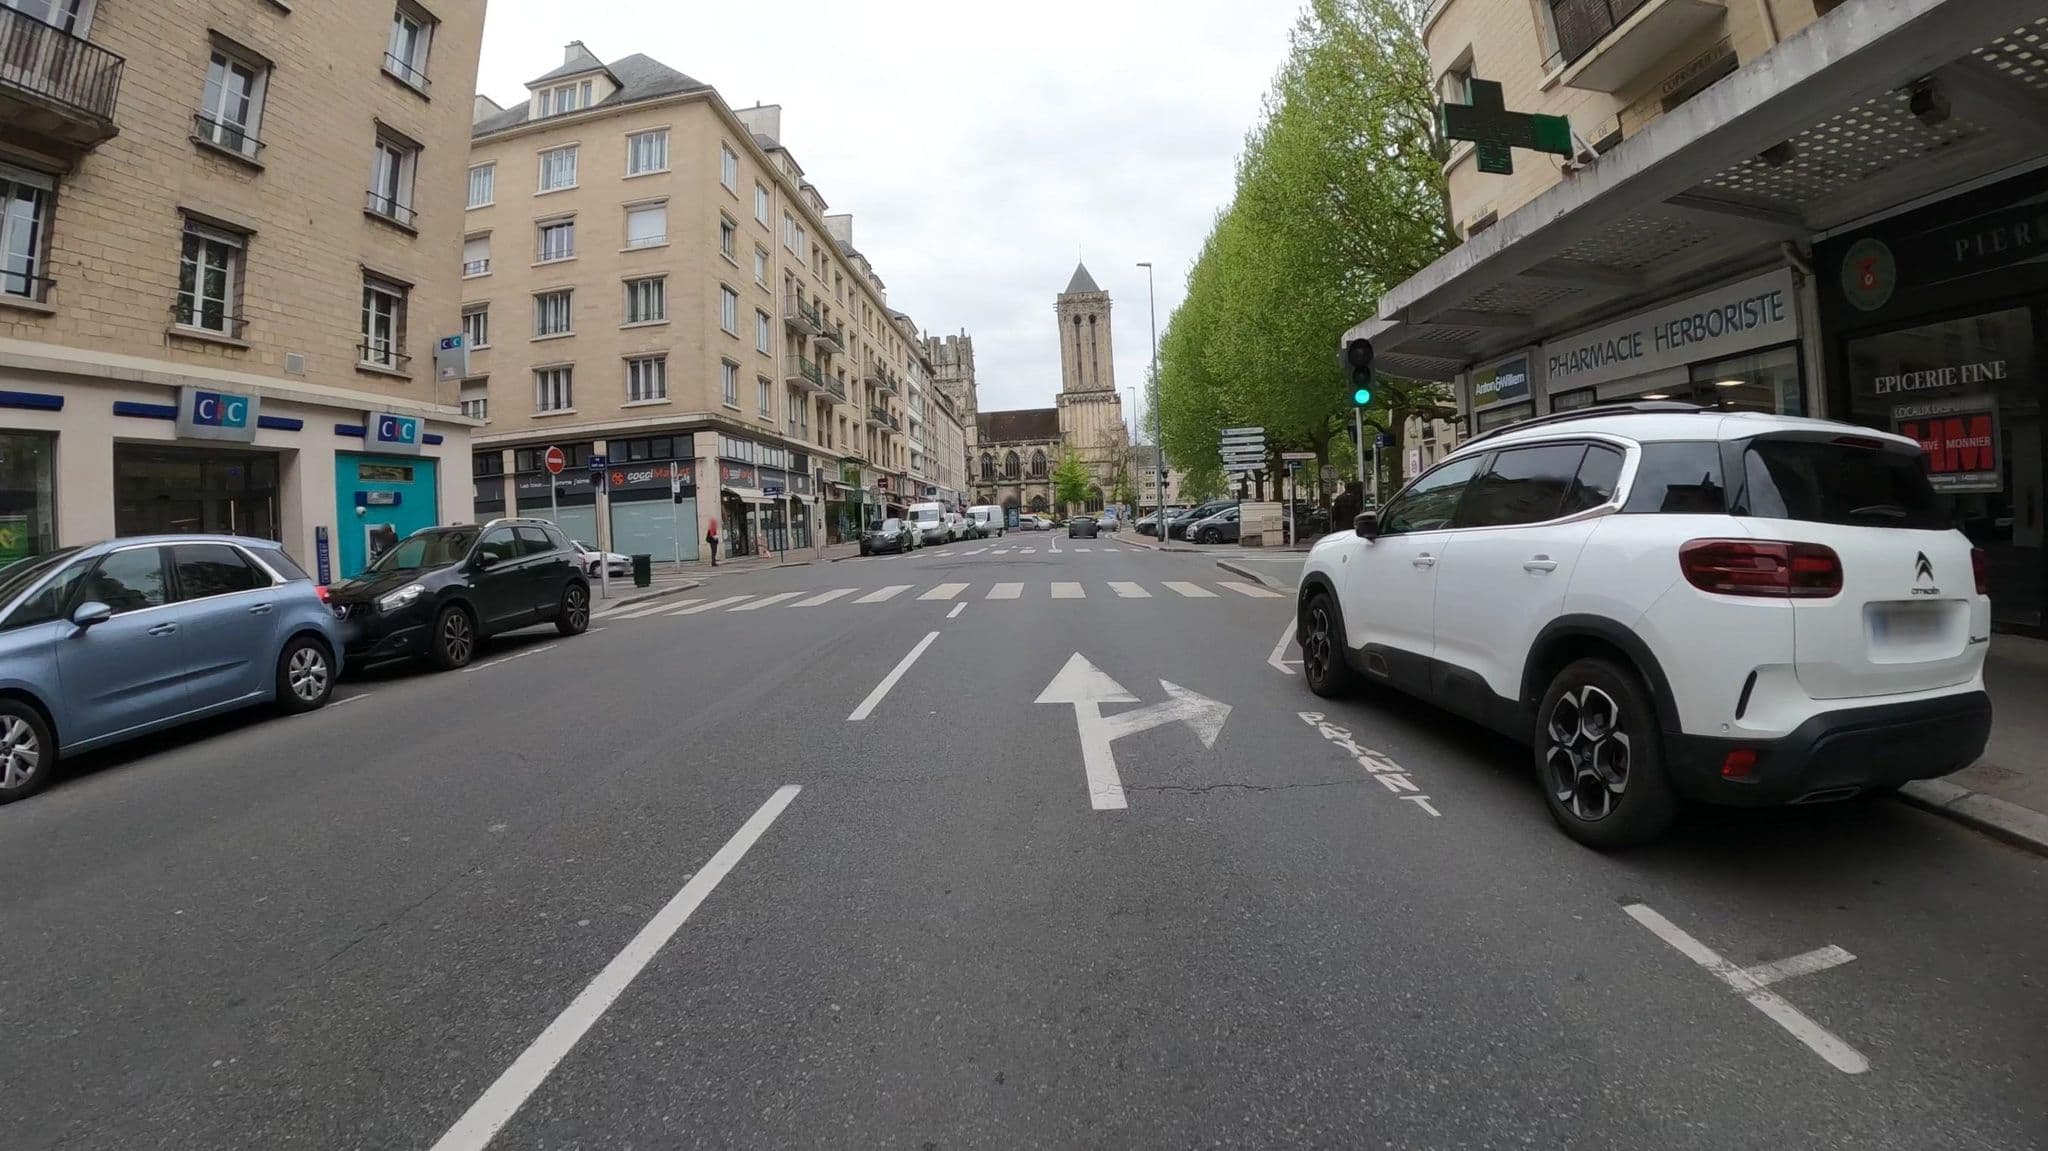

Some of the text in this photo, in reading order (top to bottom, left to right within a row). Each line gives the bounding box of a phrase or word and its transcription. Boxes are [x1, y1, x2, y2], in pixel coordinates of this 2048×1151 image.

[1549, 290, 1785, 380] PHARMACIE HERBORISTE
[1475, 373, 1525, 396] Anton&Willem
[1875, 360, 2008, 394] EPICERIE FINE
[199, 399, 243, 422] CIC
[382, 420, 413, 439] CIC
[1920, 437, 1991, 451] ERVE MONNIER
[1297, 711, 1442, 817] PAYANT
